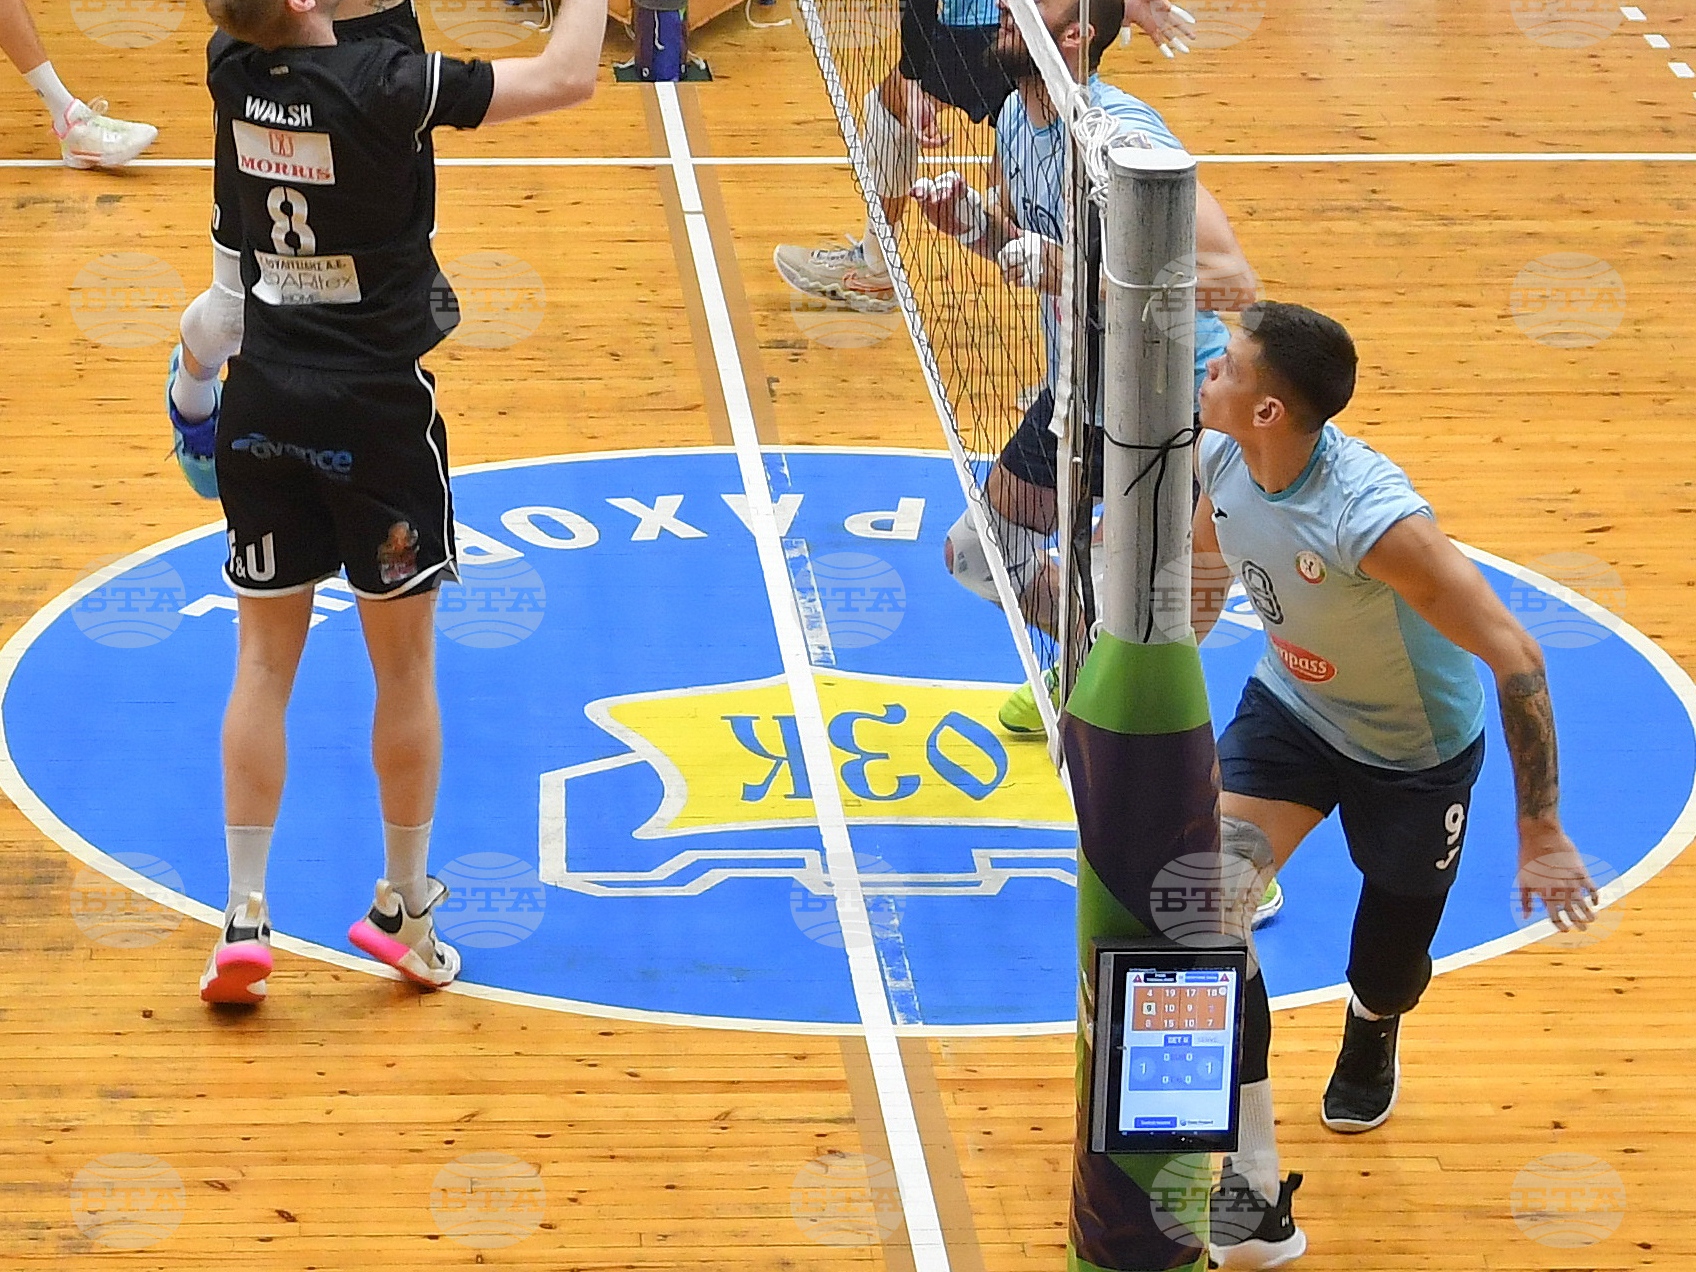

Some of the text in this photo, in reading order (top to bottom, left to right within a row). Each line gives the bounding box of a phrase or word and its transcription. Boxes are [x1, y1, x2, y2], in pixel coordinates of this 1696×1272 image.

[245, 94, 313, 127] WALSH
[240, 154, 331, 182] MORRIS
[266, 185, 316, 256] 8
[1186, 989, 1197, 997] 17
[1186, 1053, 1193, 1062] 0
